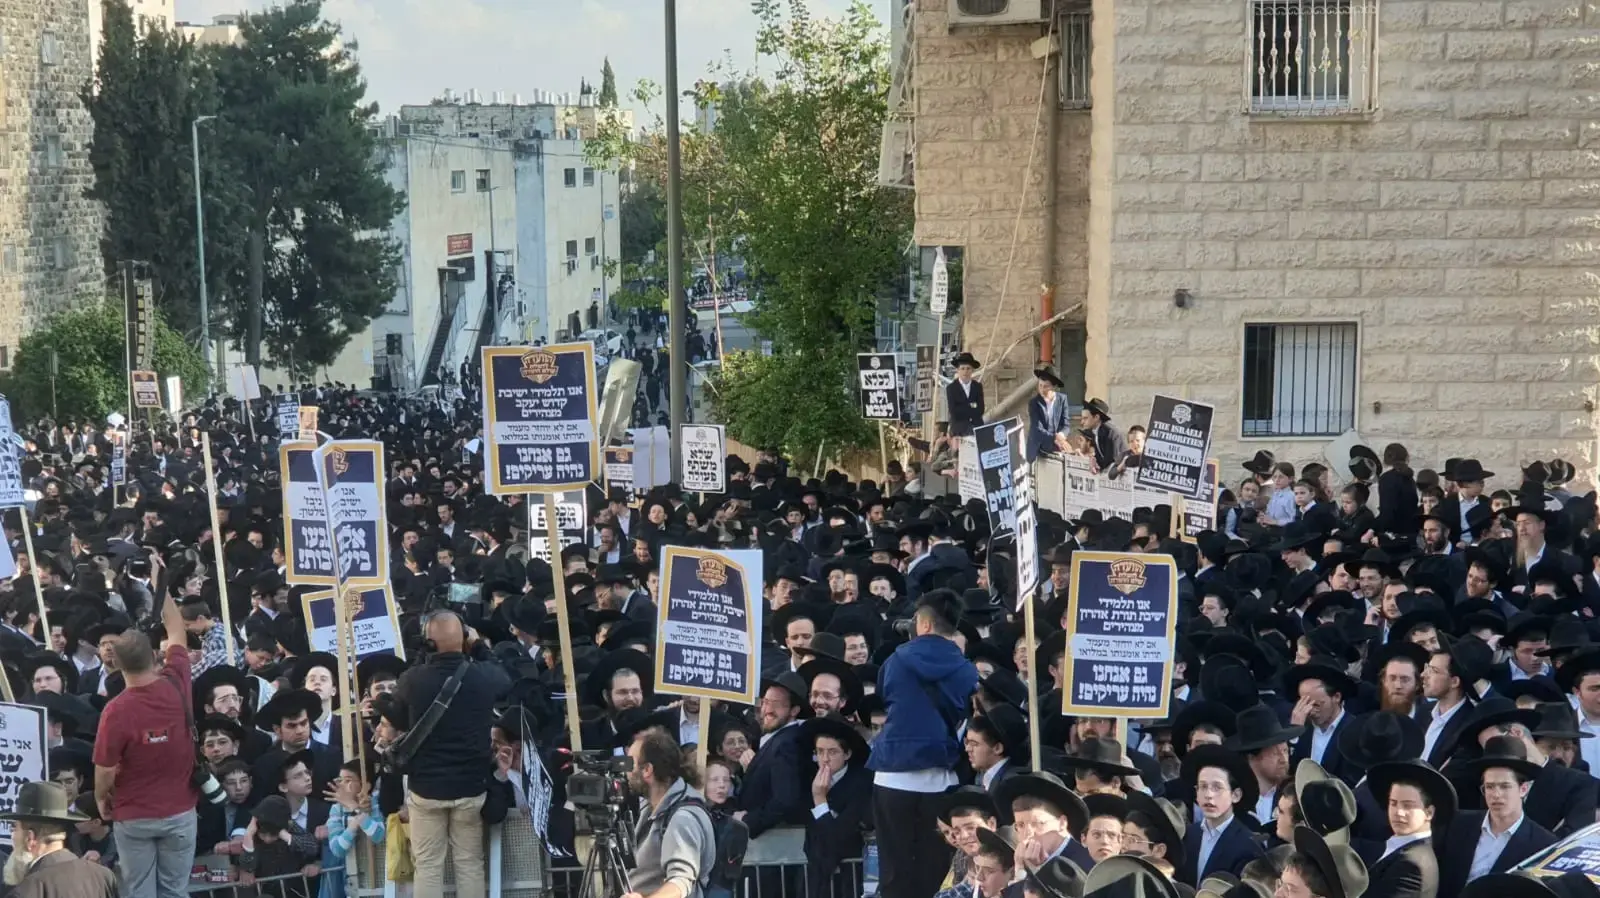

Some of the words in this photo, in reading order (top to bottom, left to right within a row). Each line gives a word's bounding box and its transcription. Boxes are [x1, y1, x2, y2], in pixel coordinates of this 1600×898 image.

[498, 388, 528, 398] ישיבת
[530, 385, 565, 397] תלמידי
[567, 385, 583, 395] אנו
[515, 399, 539, 408] יעקב
[541, 398, 568, 409] קדוש
[521, 409, 562, 418] מצהירים
[553, 423, 563, 431] לא
[1153, 421, 1171, 431] THE
[1171, 423, 1203, 438] ISRAELI
[501, 432, 529, 441] במלואו
[1150, 429, 1204, 448] AUTHORITIES
[555, 446, 572, 462] גם
[690, 449, 713, 459] שלא
[1168, 444, 1181, 453] ARE
[516, 447, 553, 463] אנחנו
[1148, 448, 1197, 464] PERSECUTING
[505, 464, 553, 480] עריקים!
[556, 463, 585, 478] נהיה
[1153, 460, 1188, 476] TORAH
[688, 471, 717, 482] פעולה
[1141, 468, 1197, 488] SCHOLARS!
[340, 487, 356, 496] אנו
[340, 498, 361, 506] ישיב
[340, 509, 368, 519] קוראי
[688, 588, 719, 602] תלמידי
[721, 594, 733, 605] אנו
[671, 597, 697, 610] אהרון
[698, 601, 721, 612] תורת
[1099, 596, 1134, 610] תלמידי
[1137, 600, 1151, 610] אנו
[691, 610, 729, 624] מצהירים
[723, 605, 744, 618] ישיבת
[1080, 608, 1109, 621] אהרון
[1111, 610, 1137, 620] תורת
[1139, 611, 1165, 621] ישיבת
[1103, 621, 1144, 633] מצהירים
[719, 630, 729, 638] לא
[359, 640, 386, 650] קוראים
[1086, 639, 1110, 647] מעמד
[1135, 640, 1144, 648] לא
[1146, 641, 1156, 649] אם
[681, 648, 715, 668] אנחנו
[718, 652, 732, 670] גם
[668, 663, 714, 684] עריקים!
[716, 669, 742, 688] נהיה
[1092, 665, 1130, 683] אנחנו
[1133, 666, 1148, 684] גם
[1078, 683, 1129, 703] עריקים!
[1132, 685, 1157, 703] נהיה
[12, 738, 32, 750] אני
